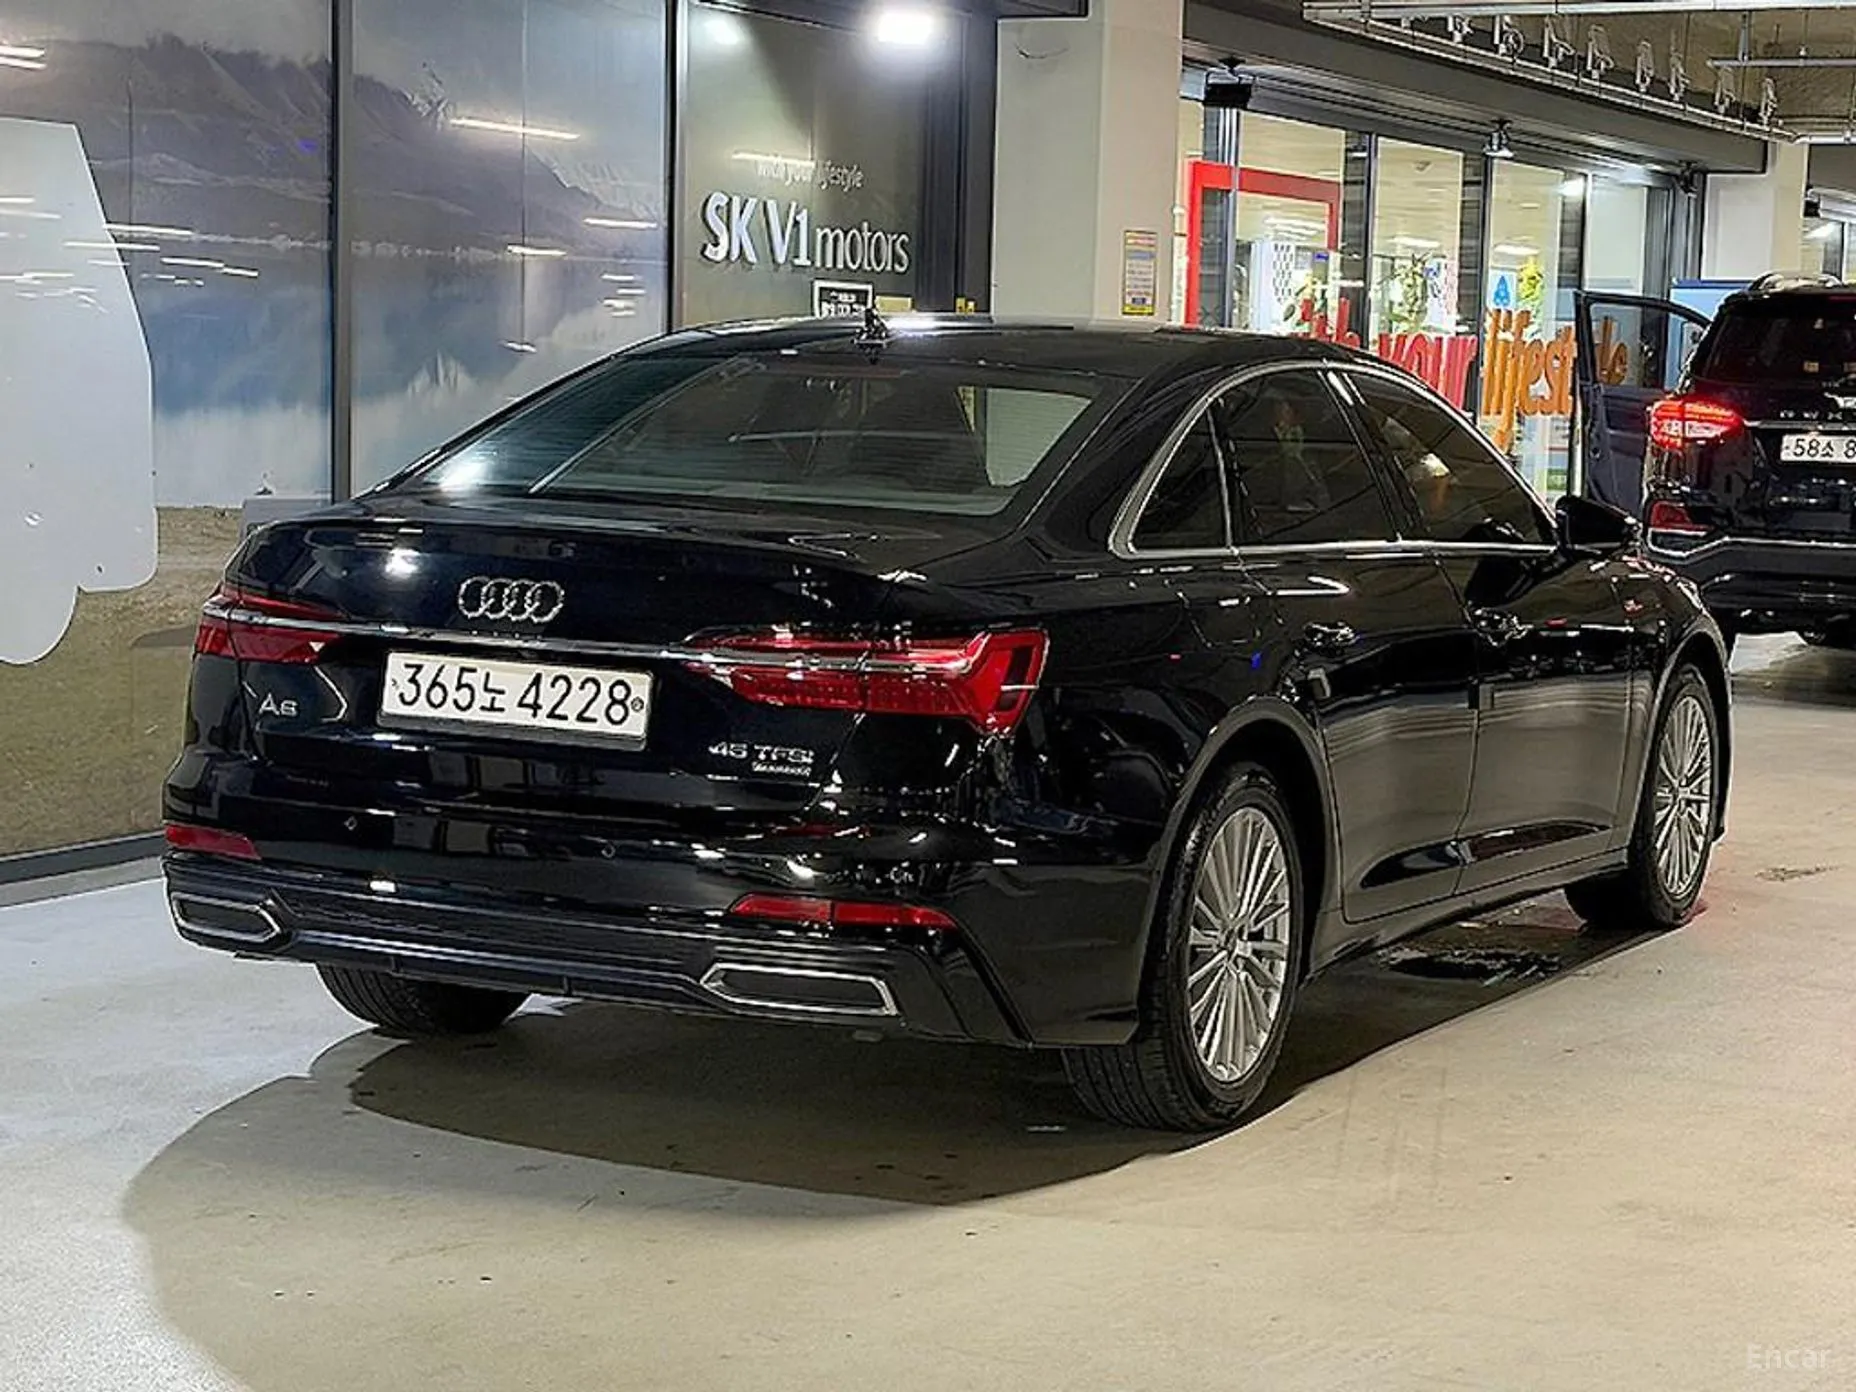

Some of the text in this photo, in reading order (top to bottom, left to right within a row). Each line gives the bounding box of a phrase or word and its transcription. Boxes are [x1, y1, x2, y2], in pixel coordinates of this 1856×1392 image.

[704, 192, 909, 273] SK V1 motors
[399, 663, 632, 726] 365노 4228
